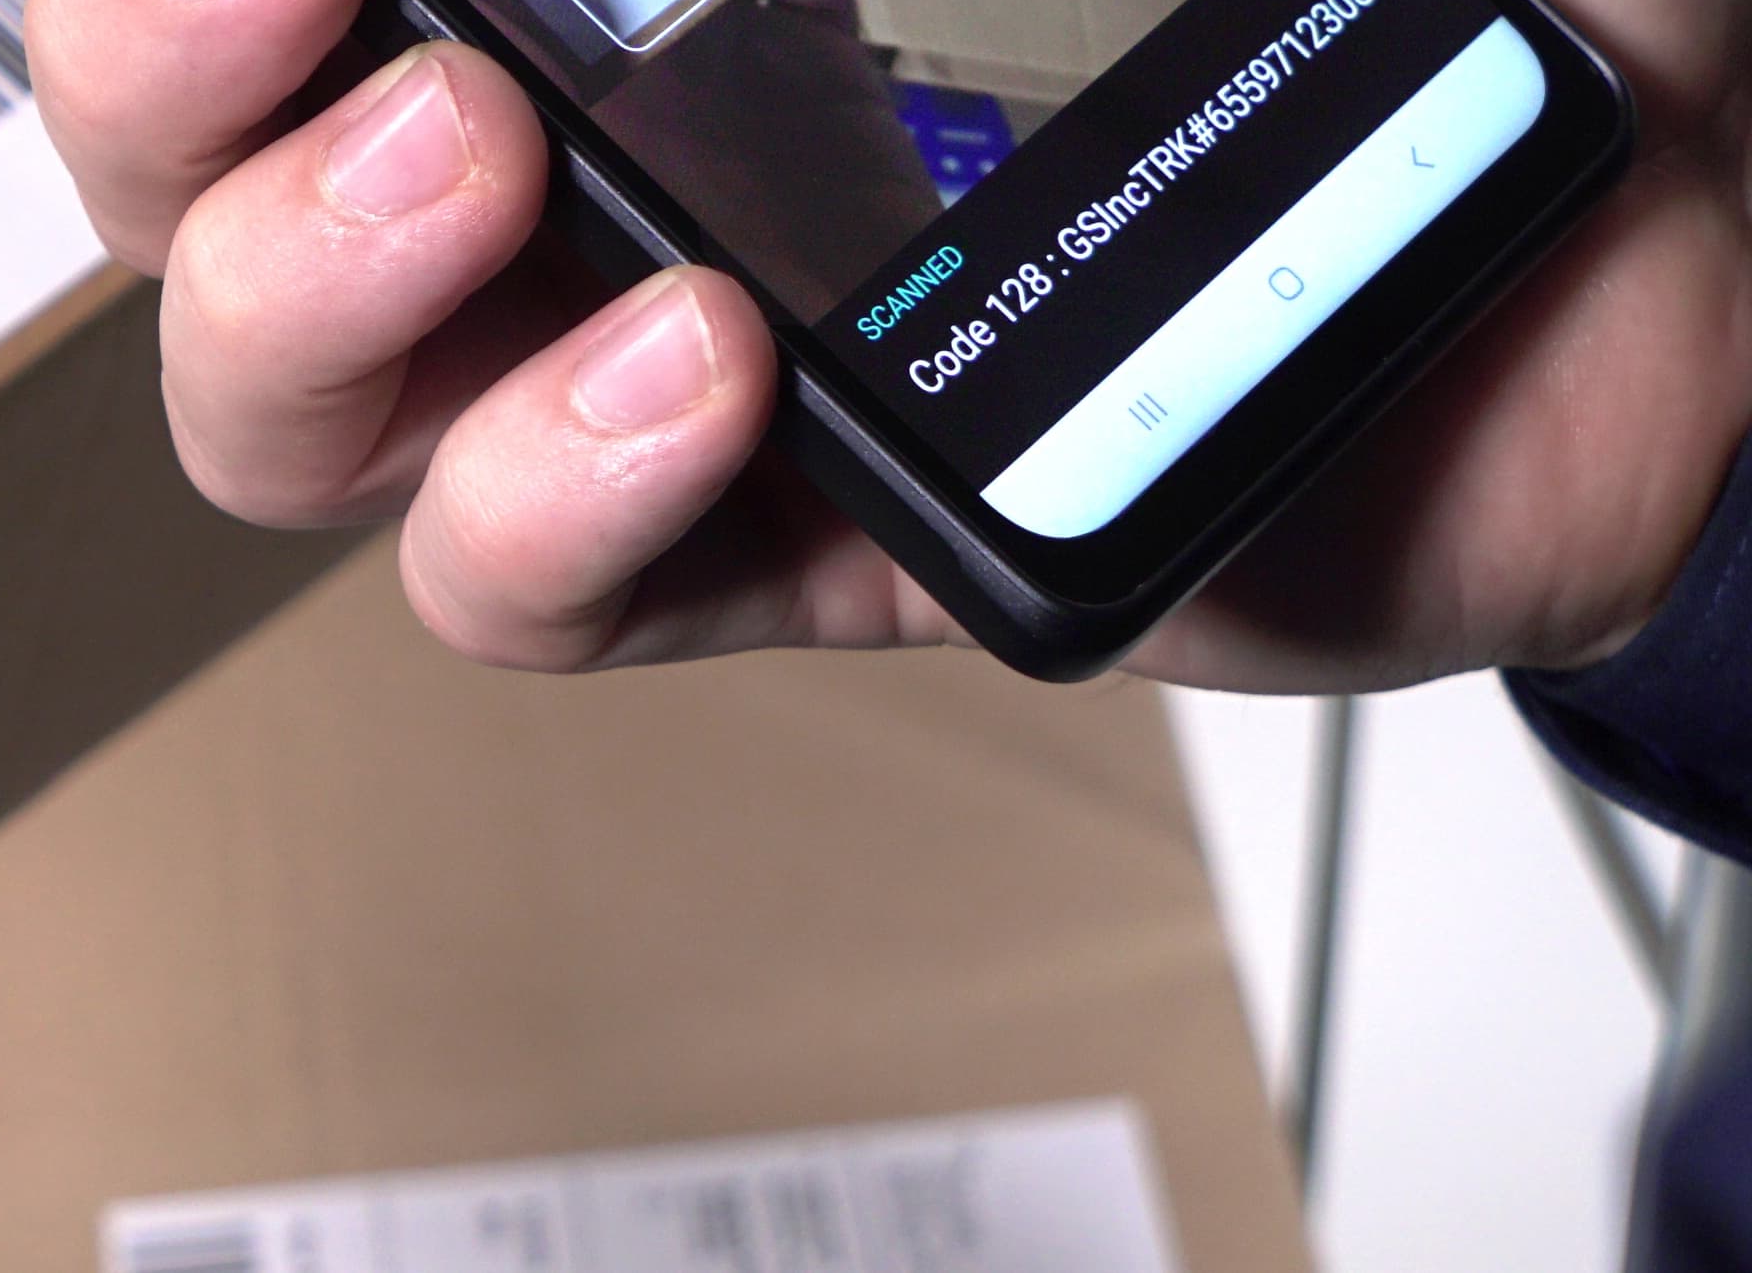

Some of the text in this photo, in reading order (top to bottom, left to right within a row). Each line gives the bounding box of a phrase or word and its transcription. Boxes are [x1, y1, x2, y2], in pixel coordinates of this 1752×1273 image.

[853, 241, 968, 344] SCANNED
[900, 307, 1000, 399] Code
[980, 258, 1058, 329] 128
